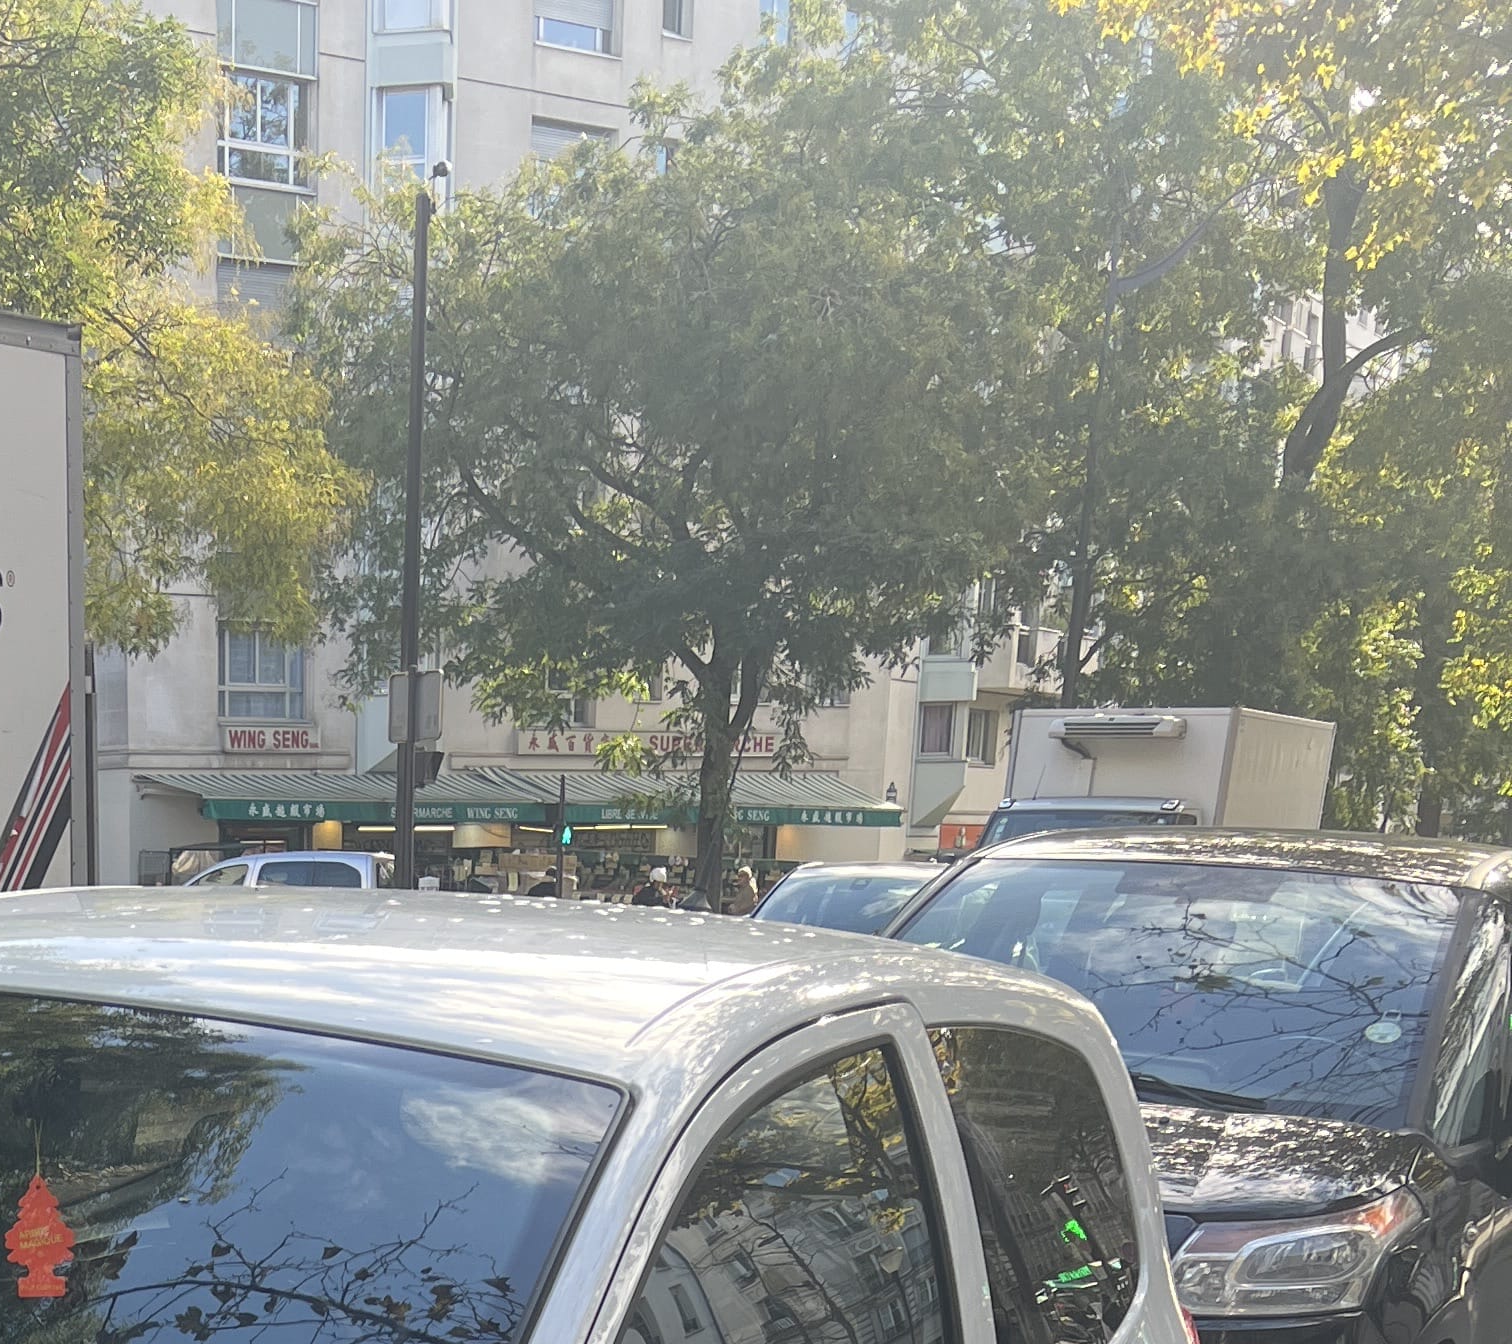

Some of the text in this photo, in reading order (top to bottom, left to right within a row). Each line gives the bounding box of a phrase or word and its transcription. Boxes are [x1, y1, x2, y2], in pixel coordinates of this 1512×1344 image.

[228, 729, 309, 749] WING SENG
[467, 807, 491, 819] WING
[493, 807, 519, 819] SENG
[746, 809, 770, 822] SENG
